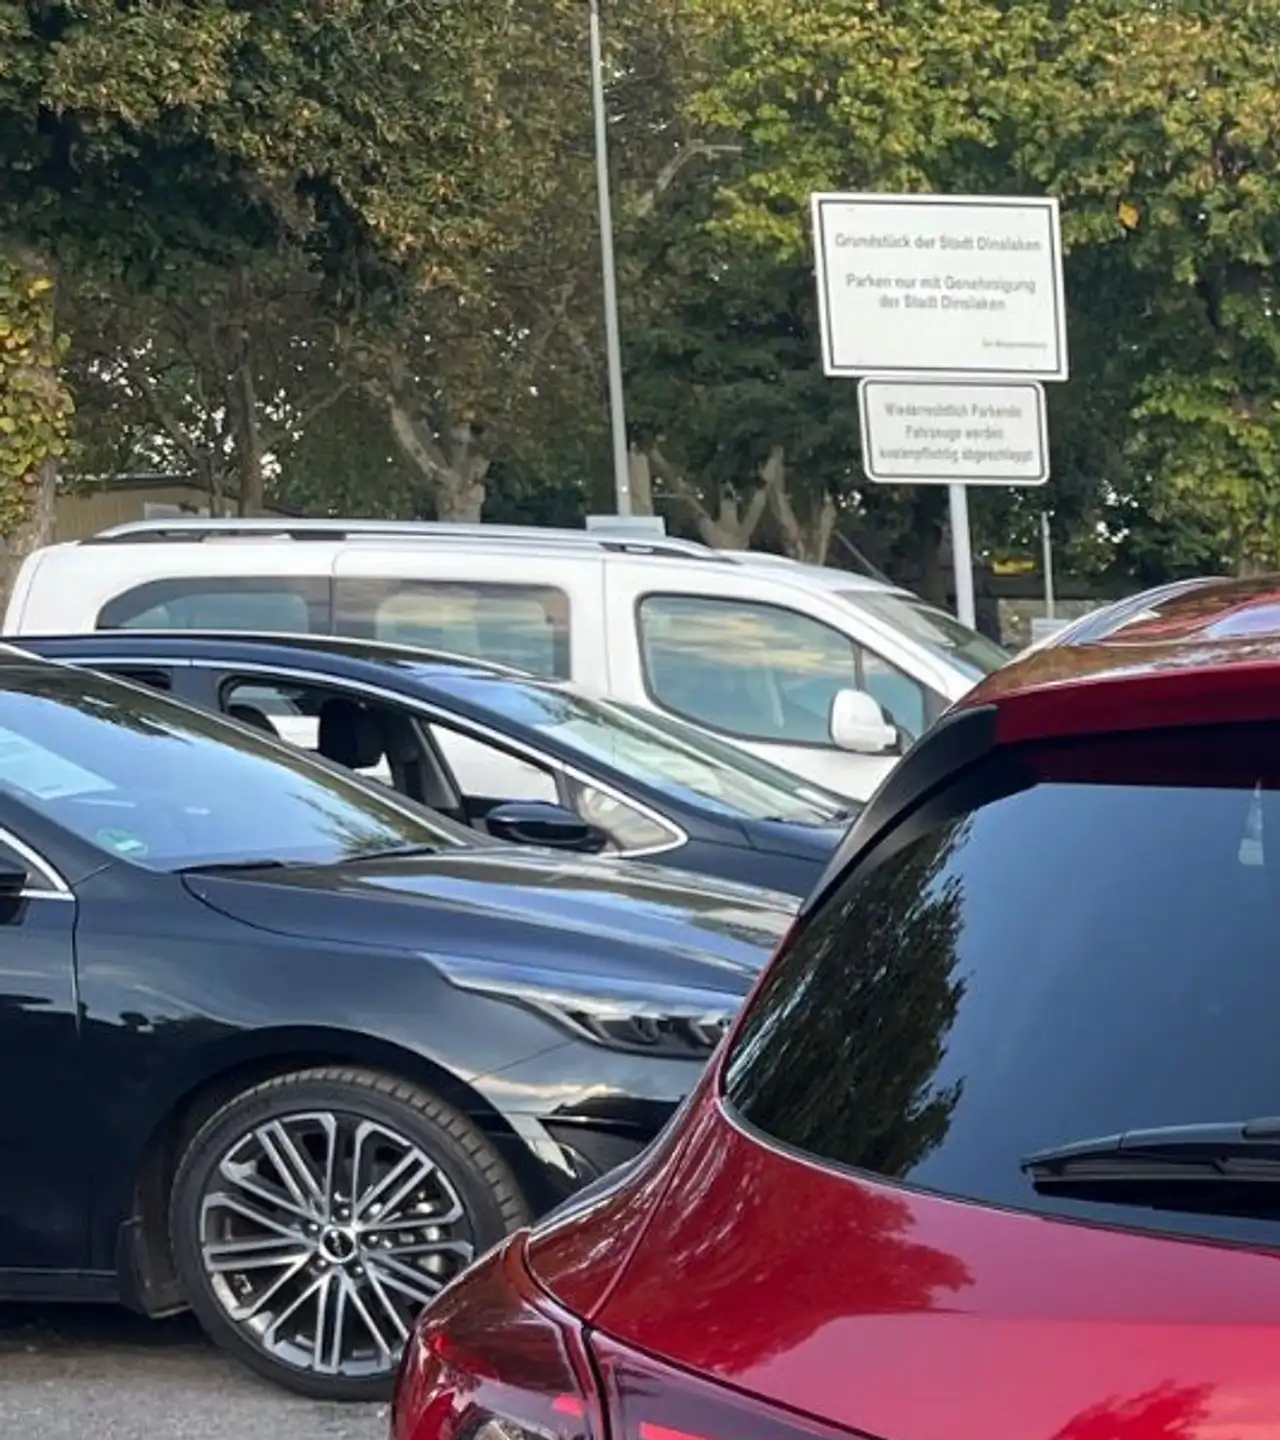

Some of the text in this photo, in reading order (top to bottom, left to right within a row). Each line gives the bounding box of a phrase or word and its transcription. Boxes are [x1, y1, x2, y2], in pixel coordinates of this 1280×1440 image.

[914, 235, 935, 249] der
[940, 234, 973, 250] Stadt
[846, 273, 891, 288] Parken
[879, 294, 899, 308] der
[904, 294, 937, 308] Stadt
